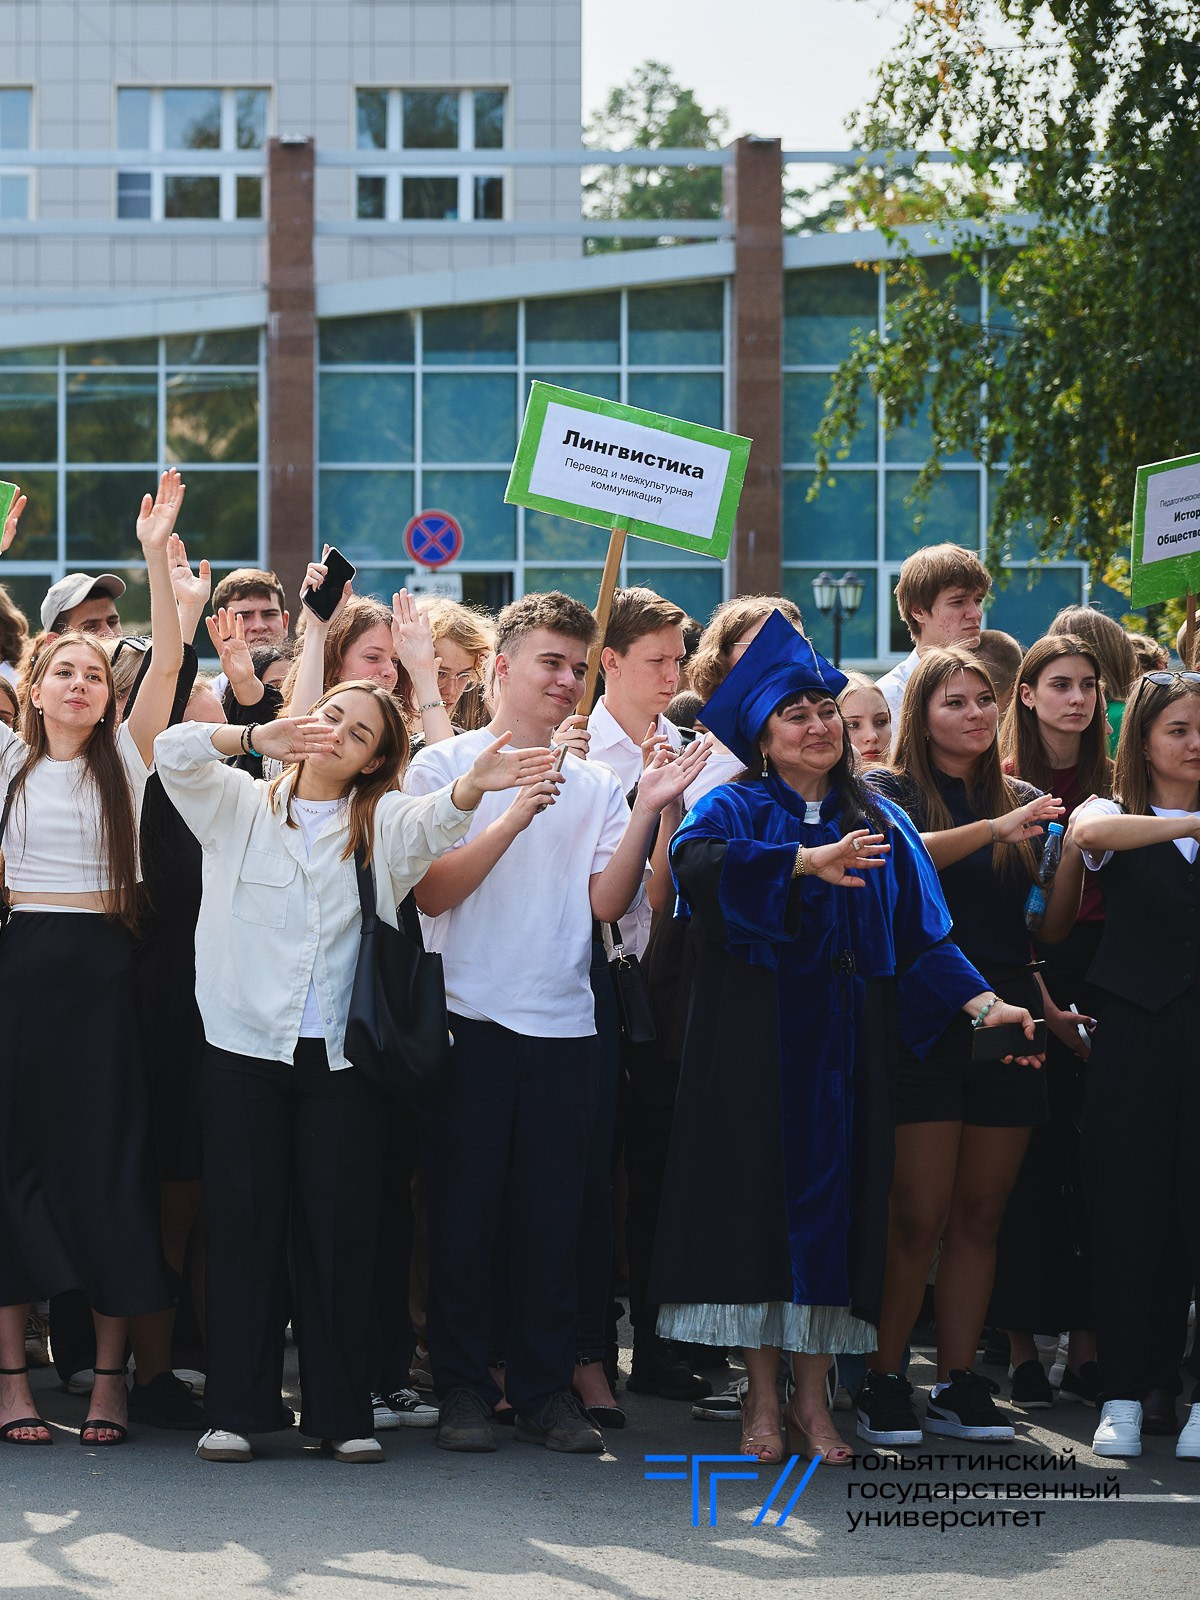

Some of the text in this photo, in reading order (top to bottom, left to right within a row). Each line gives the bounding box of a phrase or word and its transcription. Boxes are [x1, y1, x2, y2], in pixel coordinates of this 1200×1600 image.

[562, 429, 704, 480] Лингвистика
[564, 457, 694, 498] Перевод и межкультурная
[590, 480, 663, 505] коммуникация
